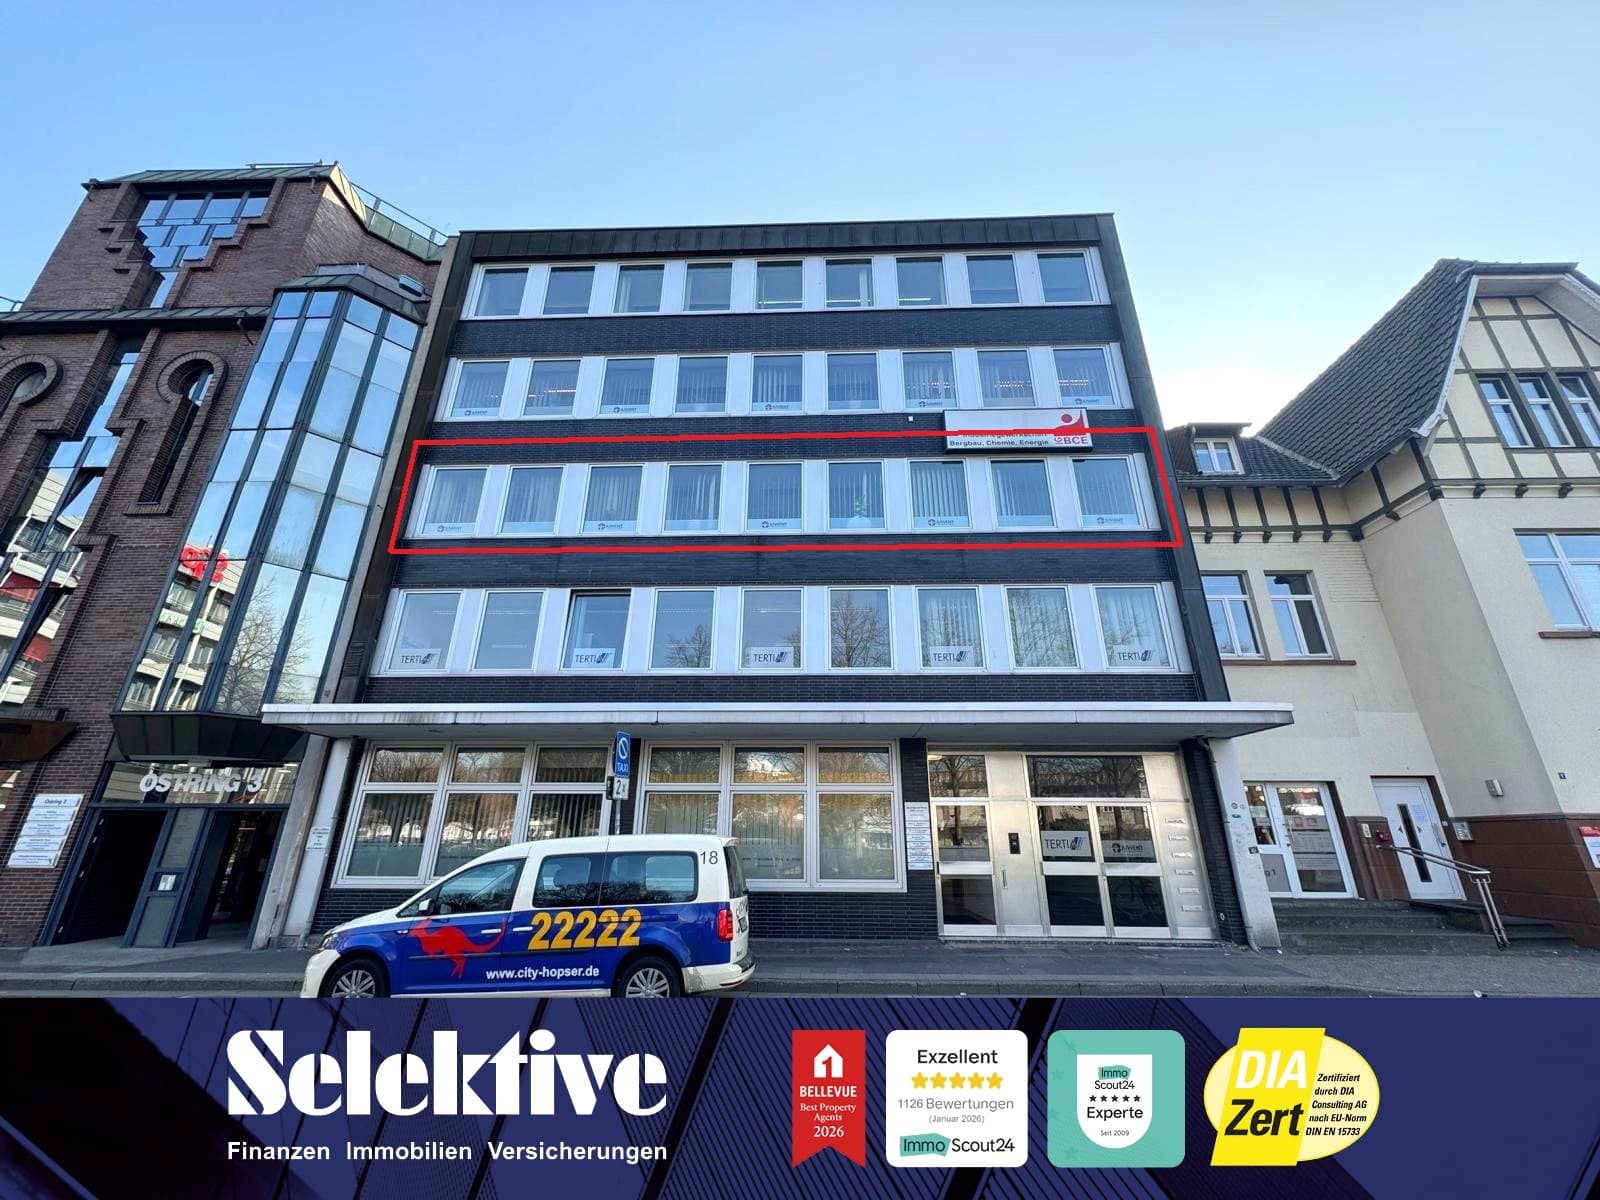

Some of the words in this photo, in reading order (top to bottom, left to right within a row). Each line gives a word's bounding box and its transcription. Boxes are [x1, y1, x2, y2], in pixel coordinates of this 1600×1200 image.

[617, 762, 628, 772] TAXI
[248, 775, 265, 793] 3
[700, 850, 718, 864] 18
[528, 908, 642, 950] 22222
[486, 965, 600, 981] www.city-hopser.de
